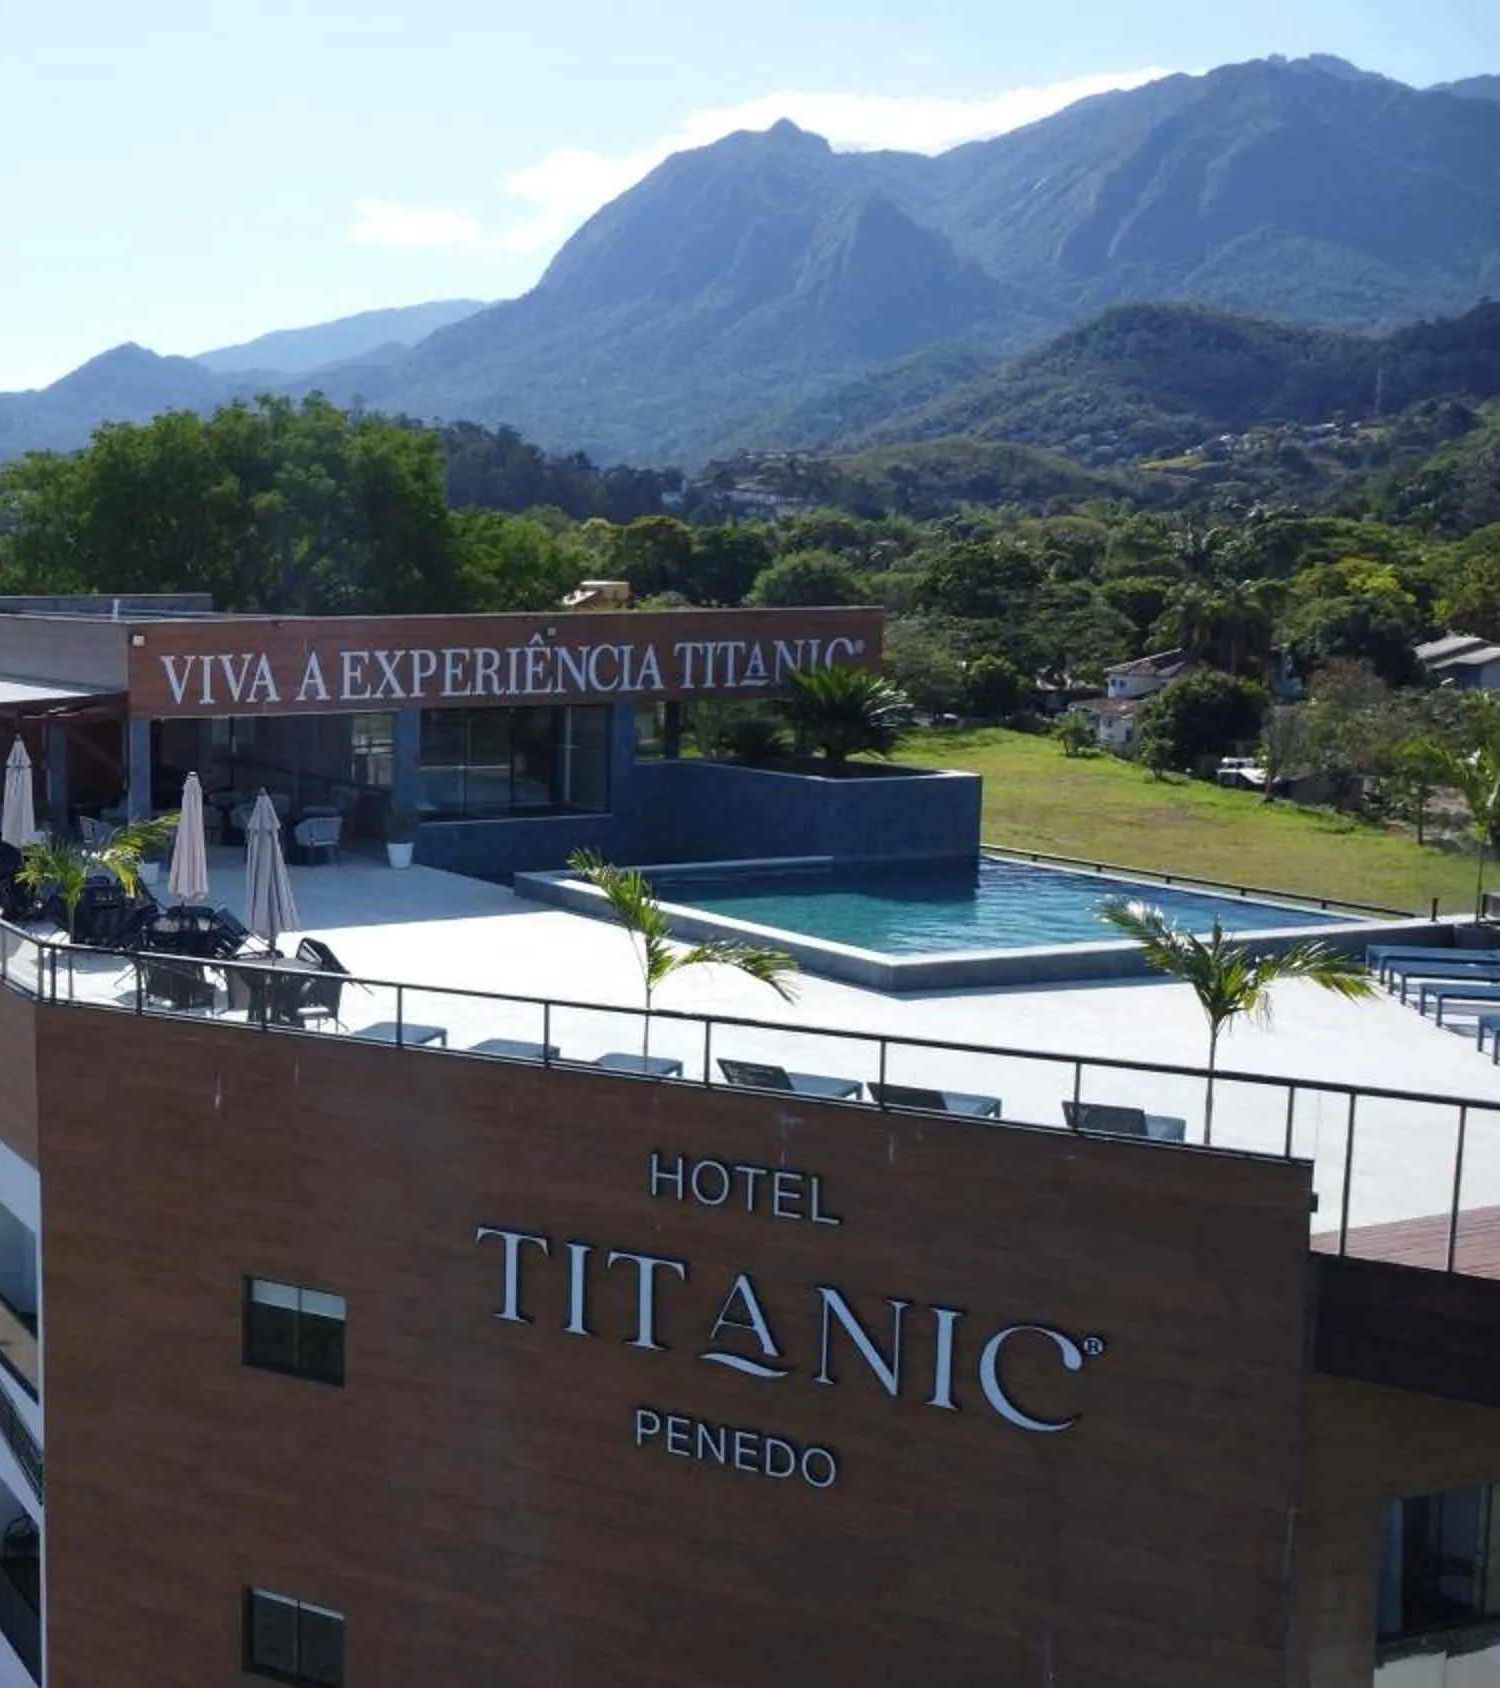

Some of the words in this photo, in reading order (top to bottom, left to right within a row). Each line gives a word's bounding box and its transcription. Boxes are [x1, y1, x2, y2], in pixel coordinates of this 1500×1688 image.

[160, 651, 281, 704] VIVA
[295, 651, 331, 700] A
[339, 632, 665, 700] EXPERIÊNCIA
[649, 1152, 842, 1225] HOTEL
[635, 1408, 838, 1488] PENEDO
